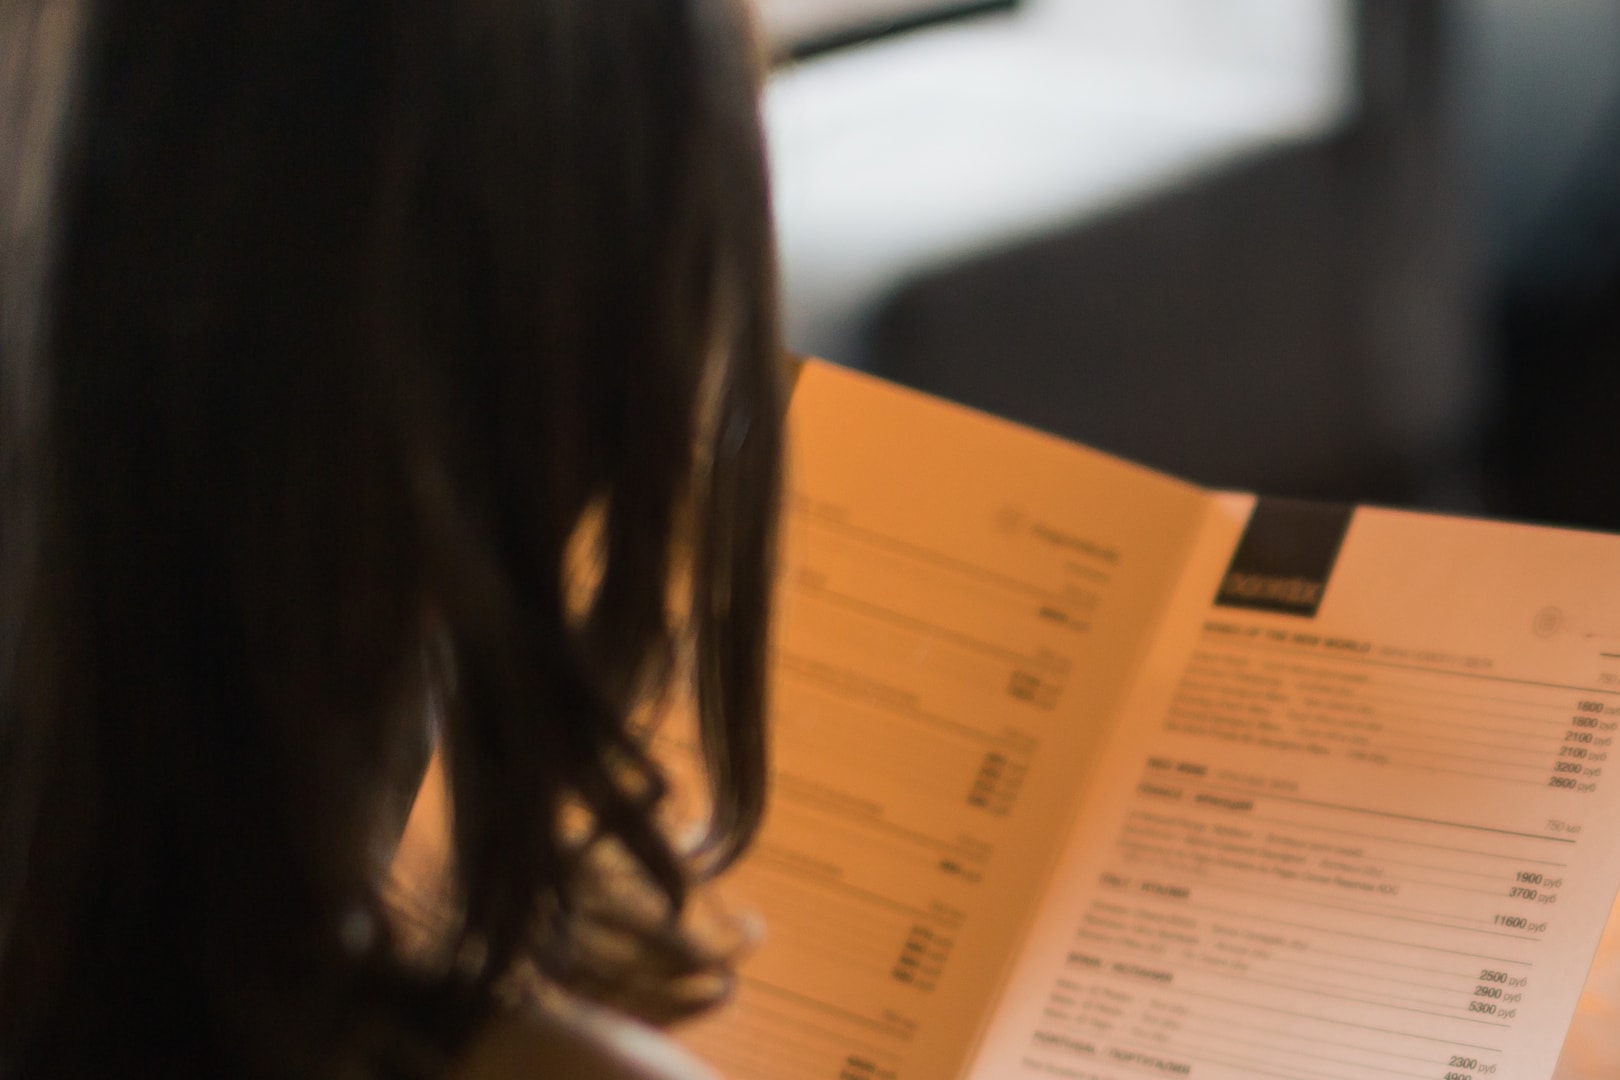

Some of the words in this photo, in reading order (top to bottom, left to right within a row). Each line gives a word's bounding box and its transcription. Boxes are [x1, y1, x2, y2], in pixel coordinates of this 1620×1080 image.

[1564, 731, 1594, 744] 2100
[1559, 746, 1588, 759] 2100
[1516, 871, 1543, 885] 1900
[1543, 878, 1563, 889] руб
[1508, 886, 1538, 901] 3700
[1537, 893, 1558, 905] руб
[1494, 914, 1528, 929] 11600
[1527, 922, 1548, 934] руб
[1479, 969, 1508, 984] 2500
[1508, 976, 1528, 988] руб
[1473, 985, 1503, 999] 2900
[1502, 992, 1522, 1003] руб
[1468, 1000, 1497, 1015] 5300
[1497, 1008, 1517, 1020] руб
[1448, 1055, 1478, 1070] 2300
[1477, 1063, 1497, 1075] руб
